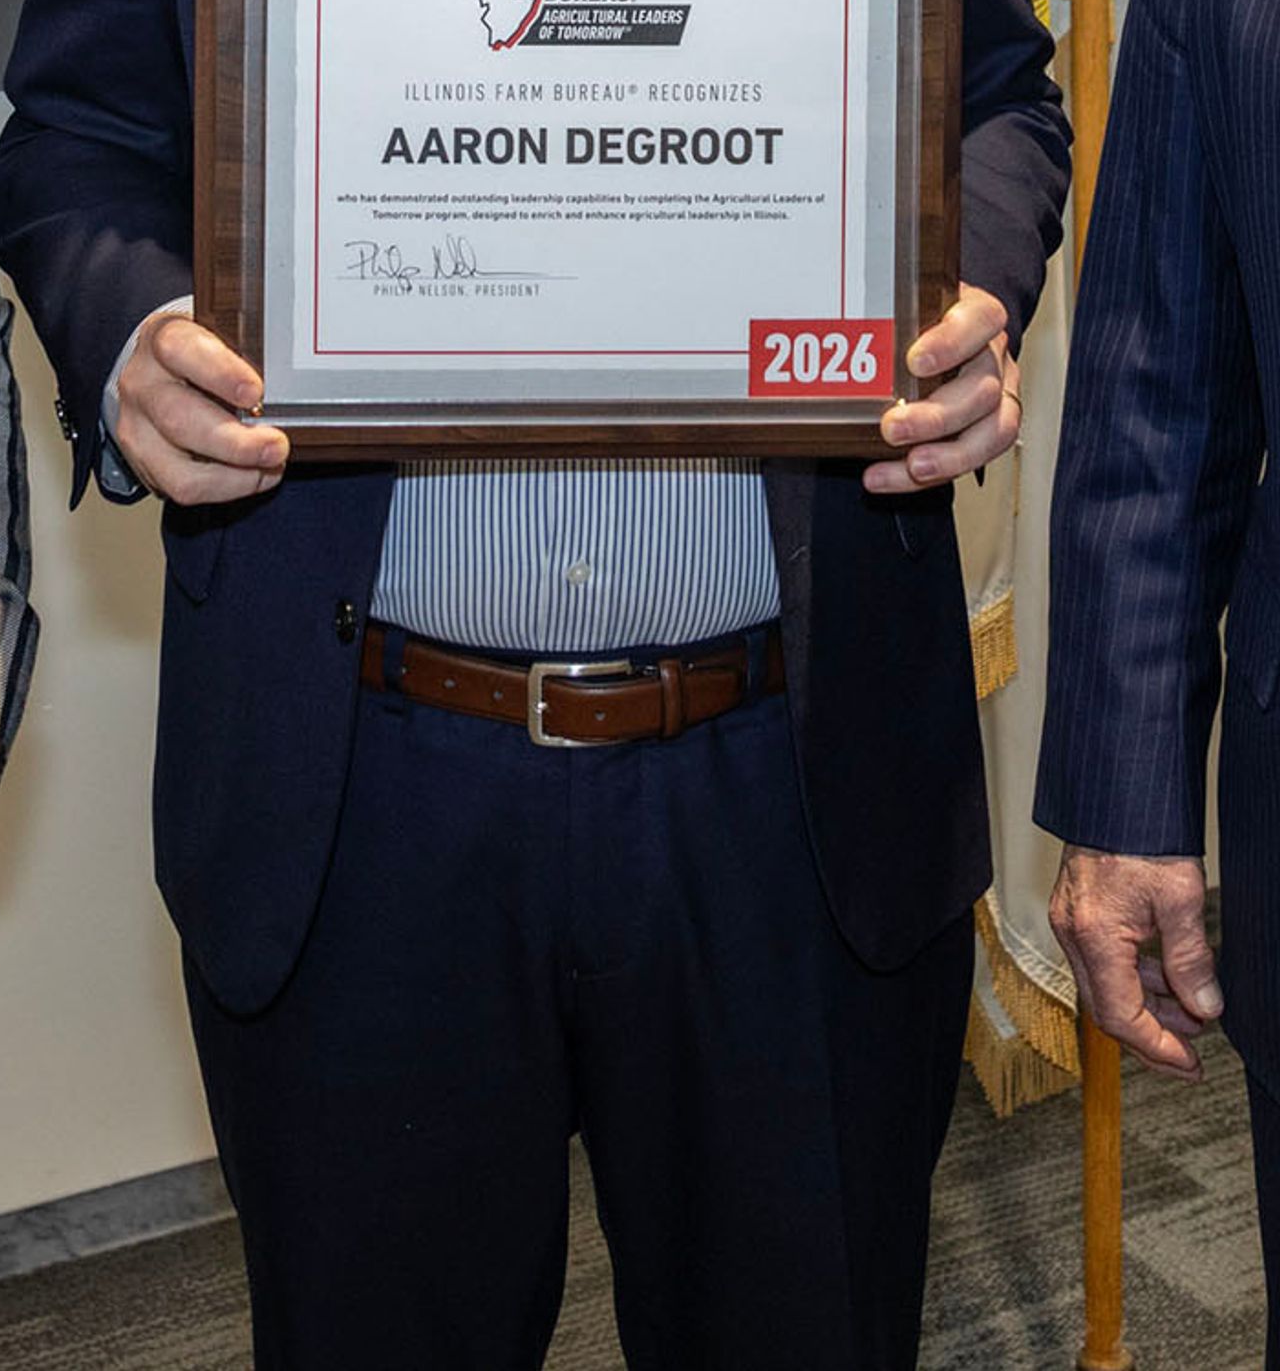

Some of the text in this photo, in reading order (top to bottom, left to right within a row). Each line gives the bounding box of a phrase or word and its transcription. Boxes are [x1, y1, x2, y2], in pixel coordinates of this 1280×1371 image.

[541, 9, 684, 25] AGRICULTURAL LEADERS
[539, 26, 555, 40] OF
[404, 83, 486, 102] ILLINOIS
[495, 83, 543, 102] FARM
[648, 83, 763, 103] RECOGNIZES
[380, 126, 784, 166] AARON DEGROOT
[336, 193, 826, 206] who has demonstrated outstanding leadership capabilities by completing the Agricultural Leaders of
[372, 210, 423, 220] Tomorrow
[471, 210, 518, 222] designed
[518, 210, 530, 220] to
[530, 210, 563, 220] enrich
[564, 210, 584, 220] and
[584, 210, 627, 220] enhance
[628, 210, 687, 222] agricultural
[687, 210, 741, 222] leadership
[742, 210, 753, 220] in
[474, 284, 540, 297] PRESIDENT
[764, 332, 878, 383] 2026
